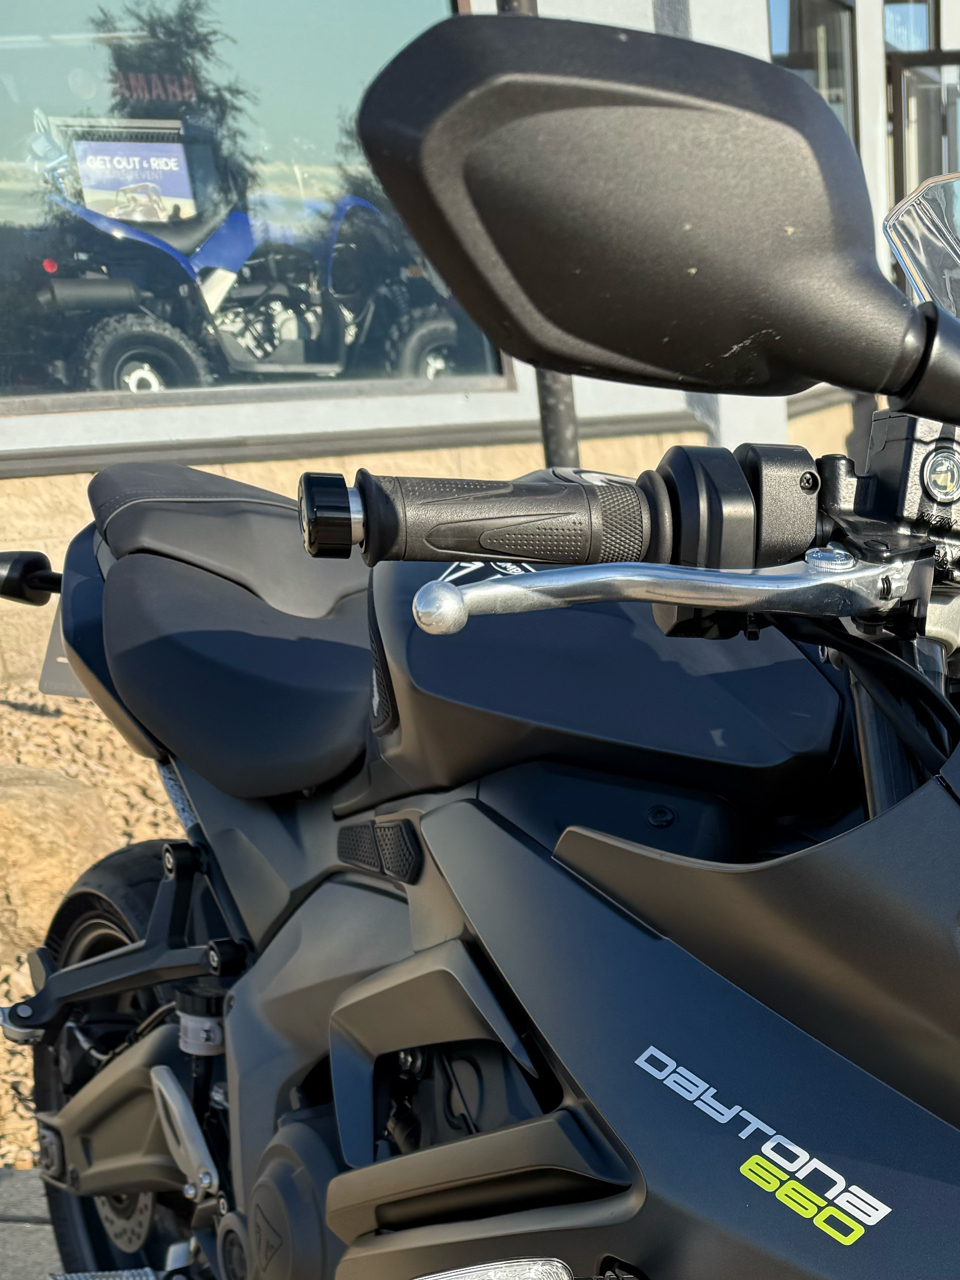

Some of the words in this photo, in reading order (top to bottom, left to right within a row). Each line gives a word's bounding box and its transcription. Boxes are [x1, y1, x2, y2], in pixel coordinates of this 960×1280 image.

[86, 155, 111, 170] GET
[113, 156, 140, 170] OUT
[150, 157, 180, 171] RIDE
[634, 1045, 893, 1226] DAYTONA
[739, 1154, 865, 1246] 660
